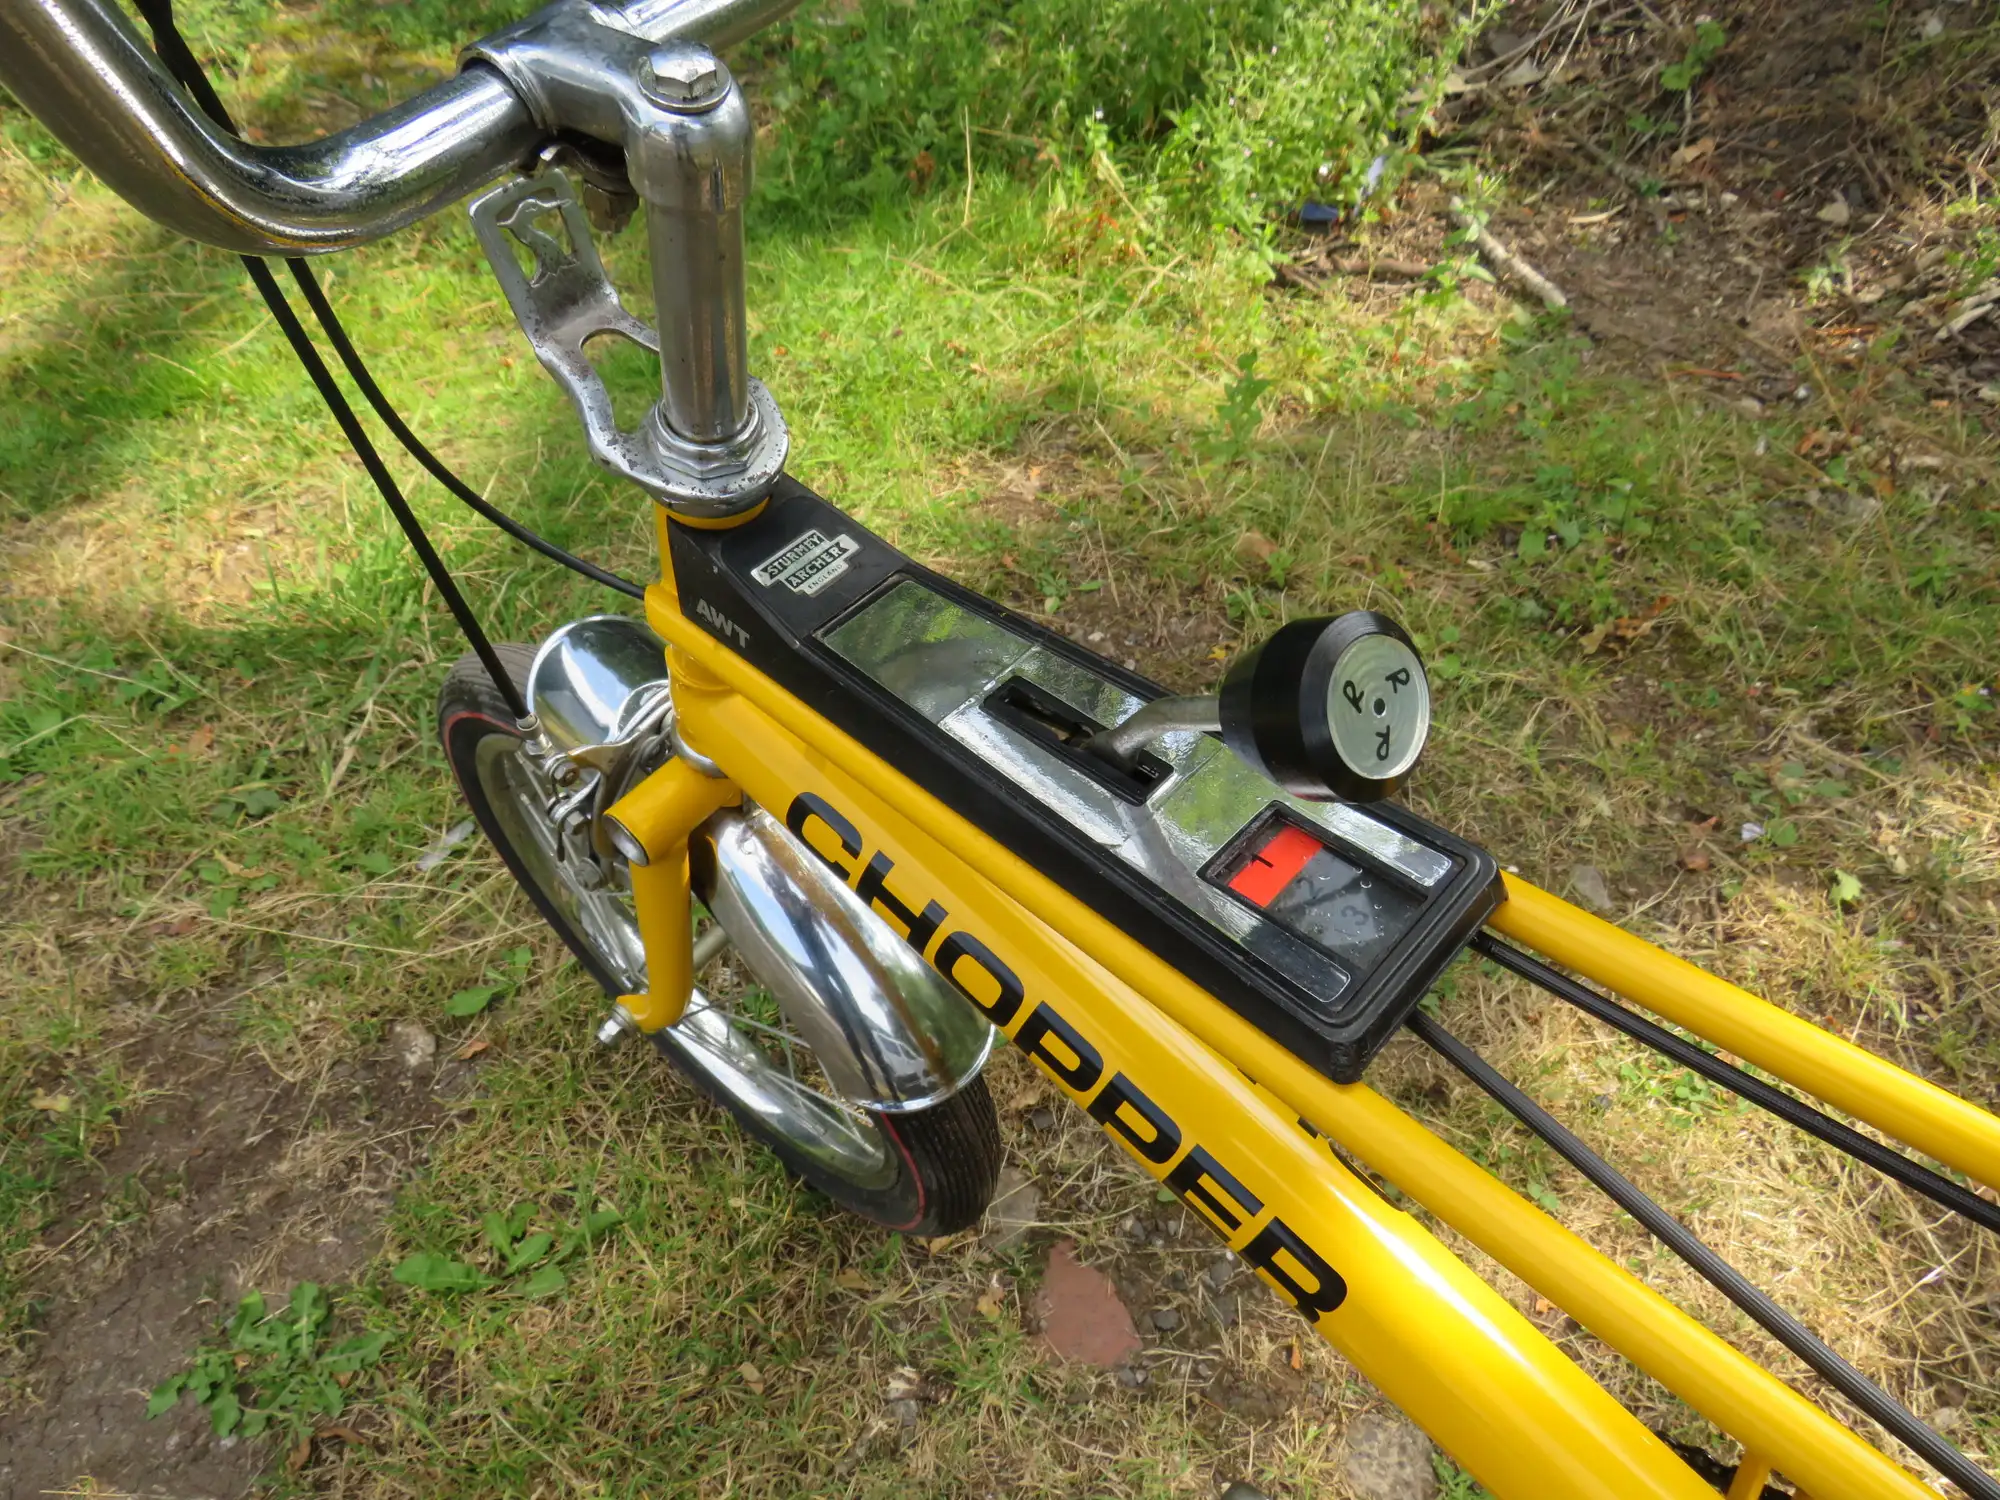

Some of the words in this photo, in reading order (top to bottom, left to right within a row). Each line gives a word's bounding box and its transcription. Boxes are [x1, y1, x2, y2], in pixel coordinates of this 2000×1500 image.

[766, 531, 822, 577] STURMEY
[787, 546, 843, 587] ARCHER
[807, 563, 843, 590] ENGLAND
[696, 598, 750, 649] AWT
[1340, 905, 1370, 926] 3
[786, 791, 1348, 1324] CHOPPER
